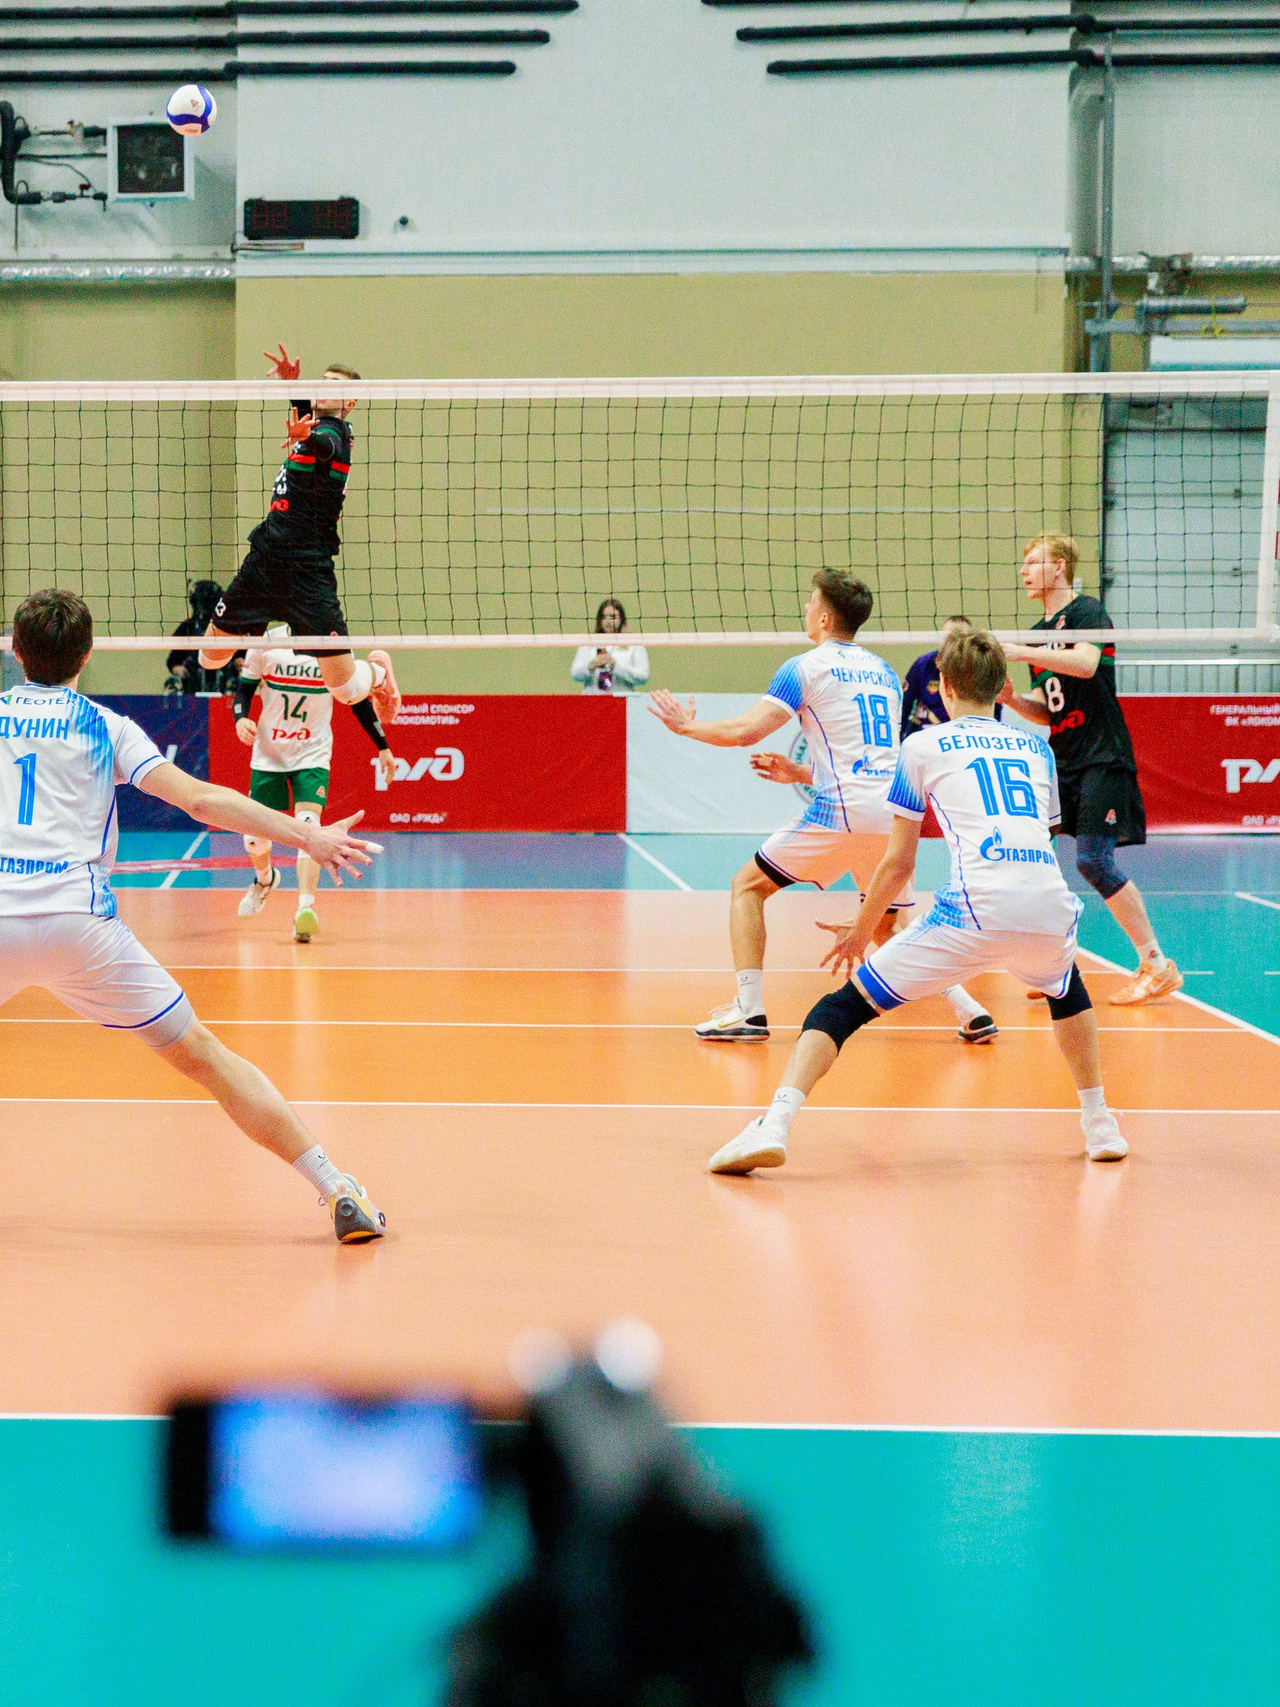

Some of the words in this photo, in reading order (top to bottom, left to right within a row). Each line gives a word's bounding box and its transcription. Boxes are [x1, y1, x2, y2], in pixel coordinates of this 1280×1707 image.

[274, 663, 323, 679] ЛОКО
[15, 695, 78, 706] ГЕОТЕК
[281, 693, 308, 723] 14
[1044, 676, 1066, 714] 8
[429, 703, 476, 715] СПОНСОР
[851, 692, 893, 748] 18
[937, 734, 1048, 758] БЕЛОЗЕРОВ
[12, 753, 37, 826] 1
[964, 757, 1039, 820] 16
[1006, 848, 1057, 867] ГАЗПРОМ
